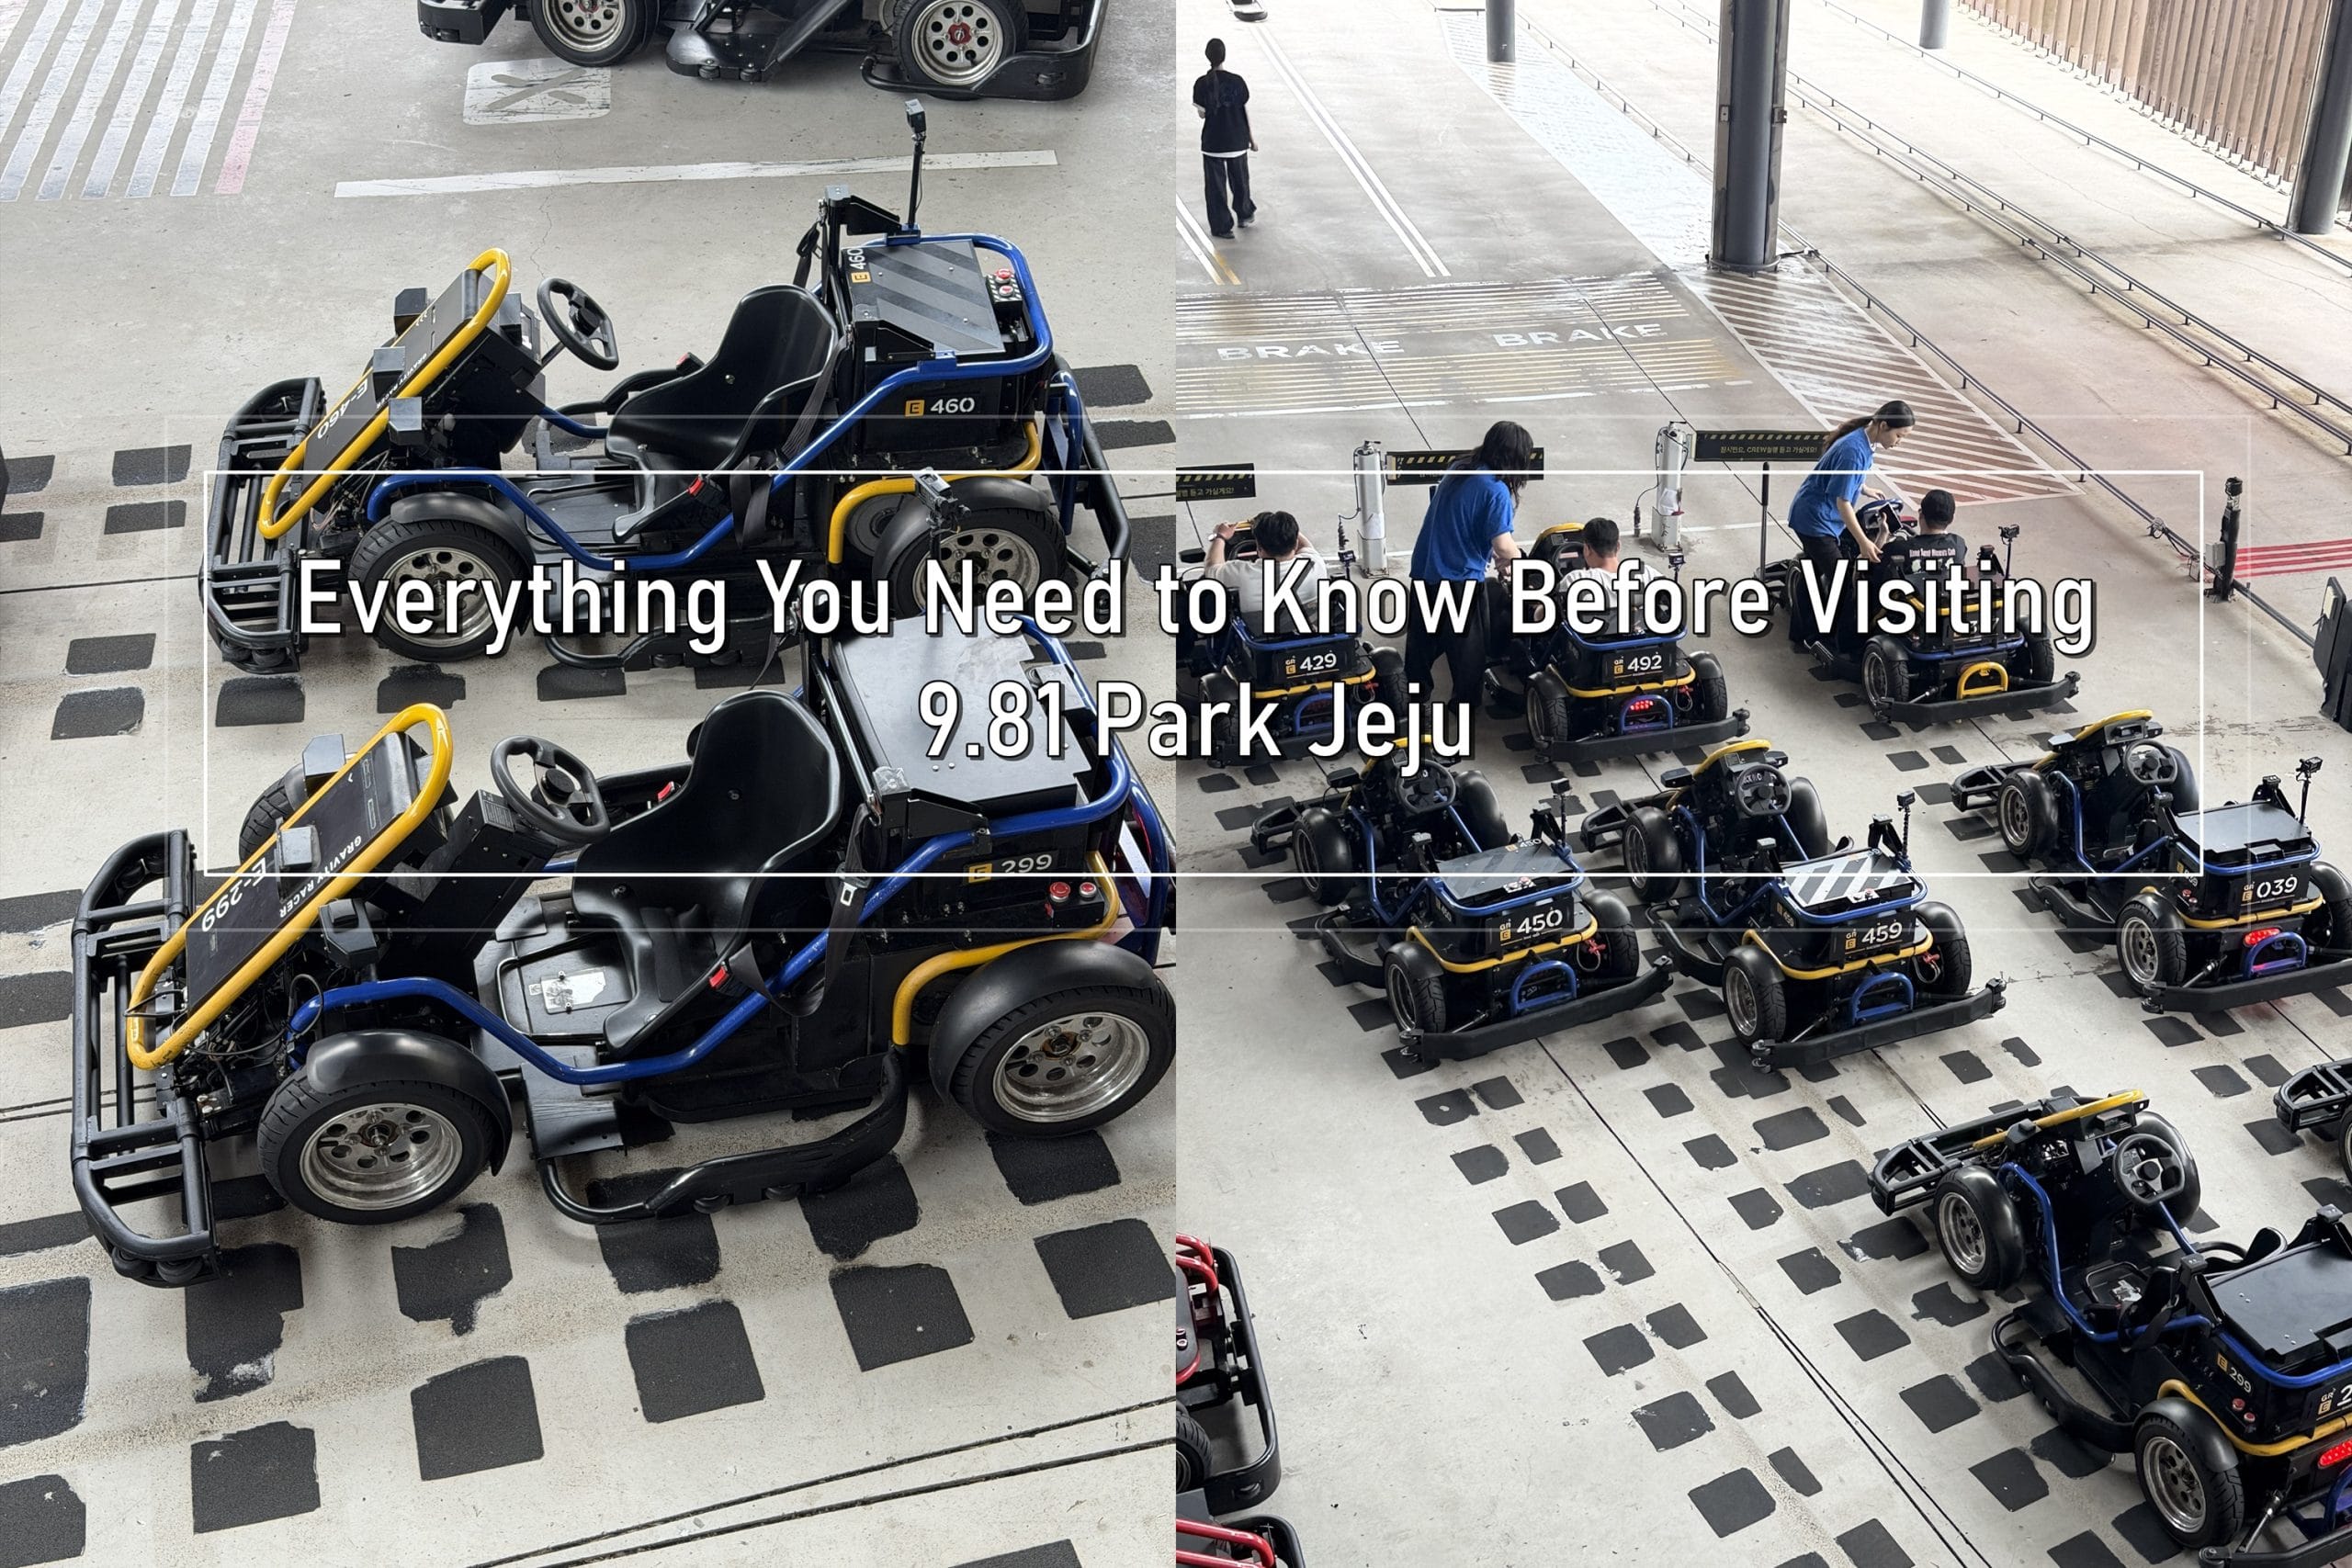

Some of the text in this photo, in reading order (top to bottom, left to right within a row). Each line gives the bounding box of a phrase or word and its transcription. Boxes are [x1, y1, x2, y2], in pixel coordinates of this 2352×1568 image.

[847, 248, 865, 270] 460
[1493, 323, 1666, 347] BRAKE
[1216, 340, 1405, 361] BRAKE
[318, 378, 368, 439] E-460
[931, 398, 975, 414] 460
[1300, 653, 1337, 671] 429
[1627, 655, 1662, 671] 492
[1001, 854, 1052, 874] 299
[279, 835, 362, 919] GRAVITY RACER
[2256, 876, 2297, 898] 039
[201, 857, 266, 932] E-299
[1517, 908, 1563, 935] 450
[1861, 922, 1903, 944] 459
[2230, 1367, 2252, 1393] 299
